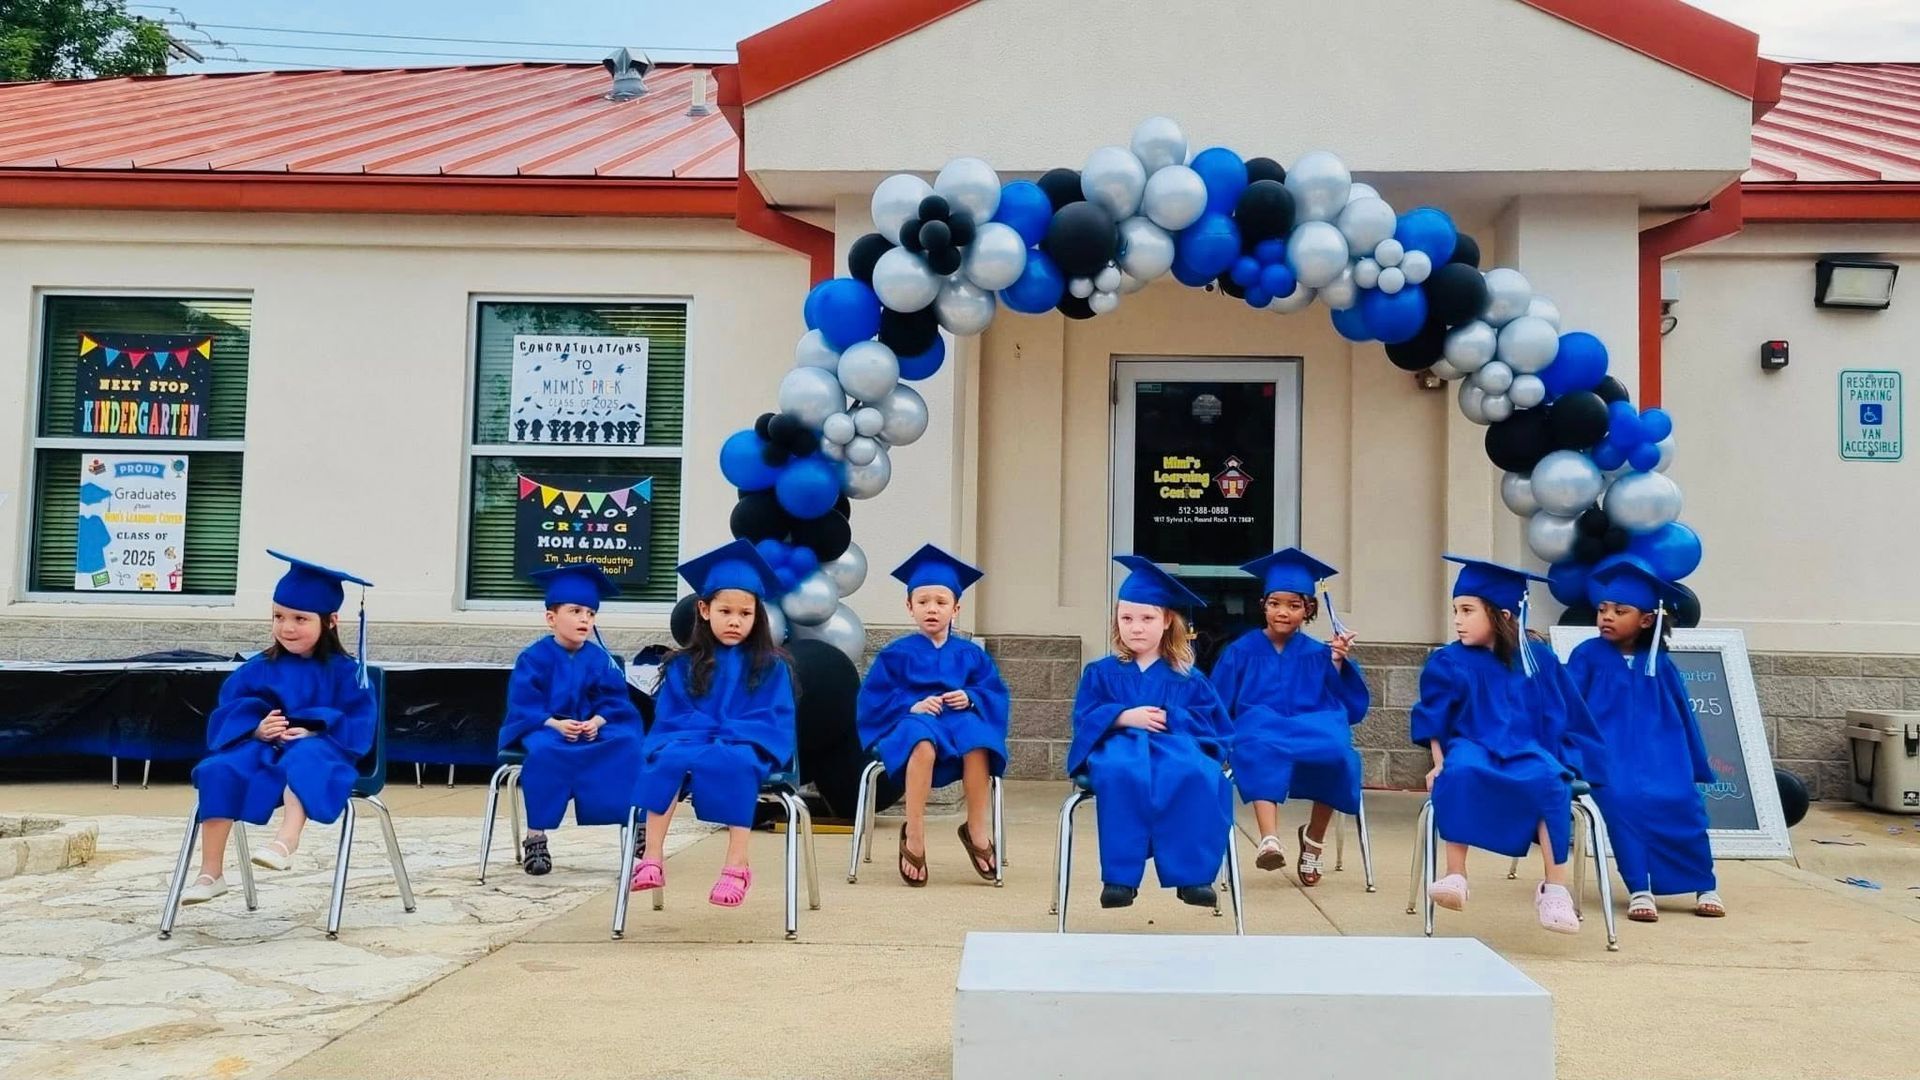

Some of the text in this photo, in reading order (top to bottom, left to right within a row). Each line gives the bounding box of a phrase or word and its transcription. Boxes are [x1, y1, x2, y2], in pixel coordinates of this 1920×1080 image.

[520, 341, 642, 356] CONGRATULATIONS
[576, 359, 592, 370] TO
[99, 378, 190, 394] NEXT STOP
[543, 377, 621, 395] MIMI'S PRE-K
[1846, 377, 1896, 389] RESERVED
[1850, 389, 1892, 401] PARKING
[548, 398, 619, 409] CLASS OF 2025
[82, 400, 200, 437] KINDERGARTEN
[1862, 428, 1882, 440] VAN
[1844, 441, 1898, 453] ACCESSIBLE
[1163, 455, 1201, 469] Mimi's
[119, 464, 160, 475] PROUD
[1153, 470, 1210, 488] Learning
[114, 487, 177, 500] Graduates
[1160, 484, 1204, 499] Center
[552, 505, 638, 518] STOP
[1178, 506, 1229, 514] 512-388-0888
[541, 521, 628, 533] CRYING
[116, 532, 169, 541] CLASS OF
[537, 535, 575, 549] MOM
[578, 536, 590, 550] &
[122, 549, 156, 567] 2025
[544, 553, 634, 567] I'm Just Graduating
